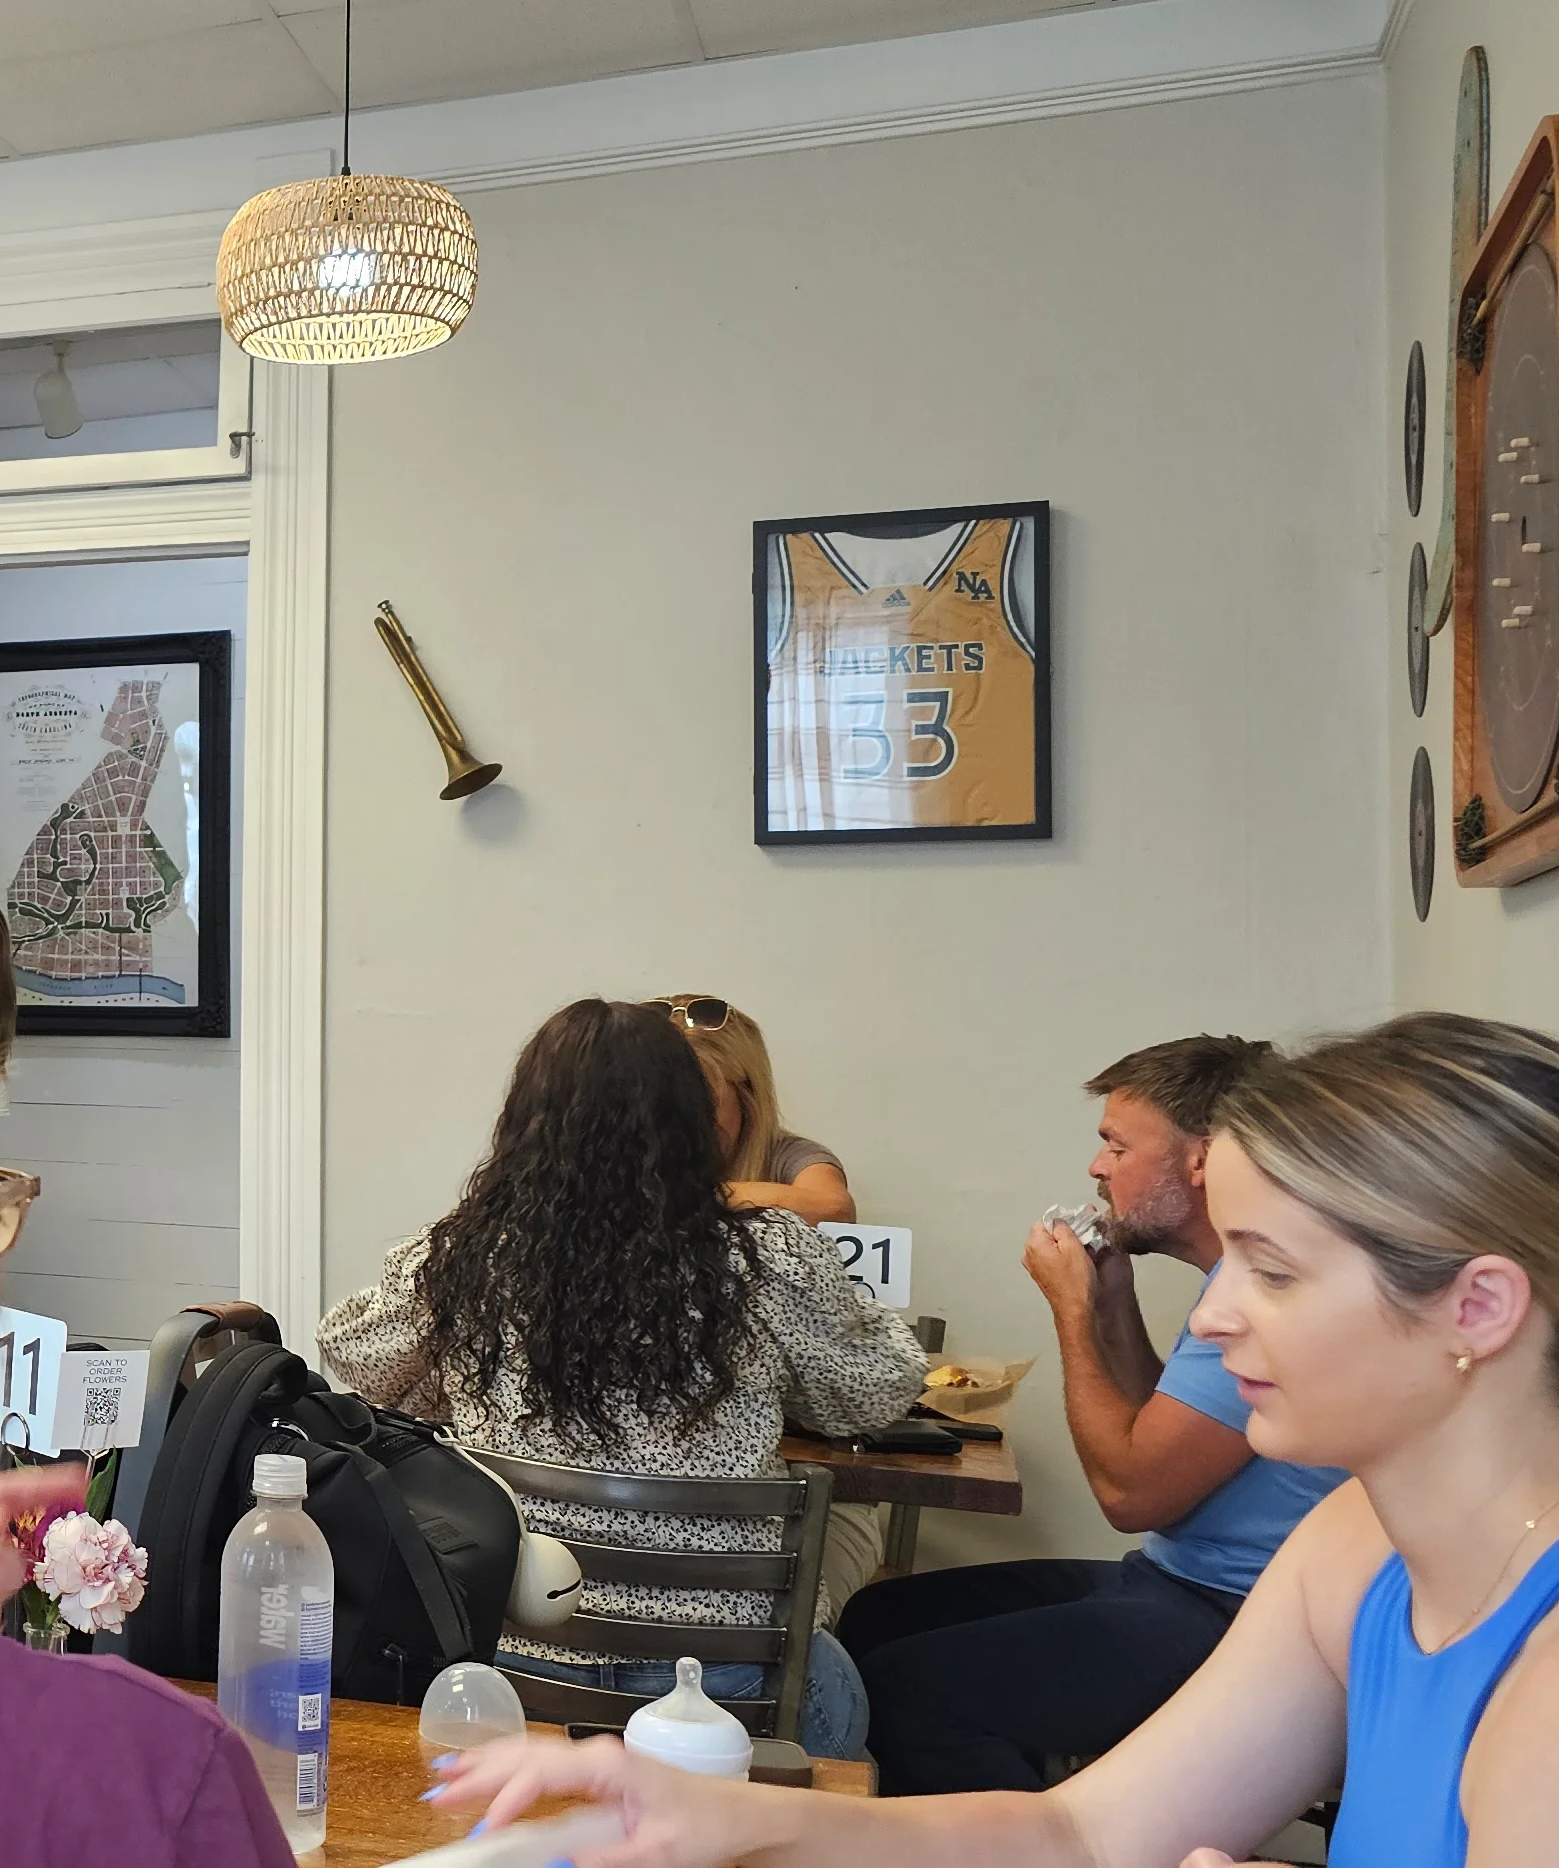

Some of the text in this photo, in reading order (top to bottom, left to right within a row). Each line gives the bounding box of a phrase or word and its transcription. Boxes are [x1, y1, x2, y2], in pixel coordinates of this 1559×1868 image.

[954, 571, 996, 601] NA
[819, 641, 986, 679] JACKETS
[43, 709, 78, 717] AUGUSTA
[841, 688, 959, 781] 33
[835, 1235, 891, 1284] 21
[85, 1358, 128, 1367] SCAN TO
[89, 1367, 123, 1376] ORDER
[82, 1375, 128, 1384] FLOWERS
